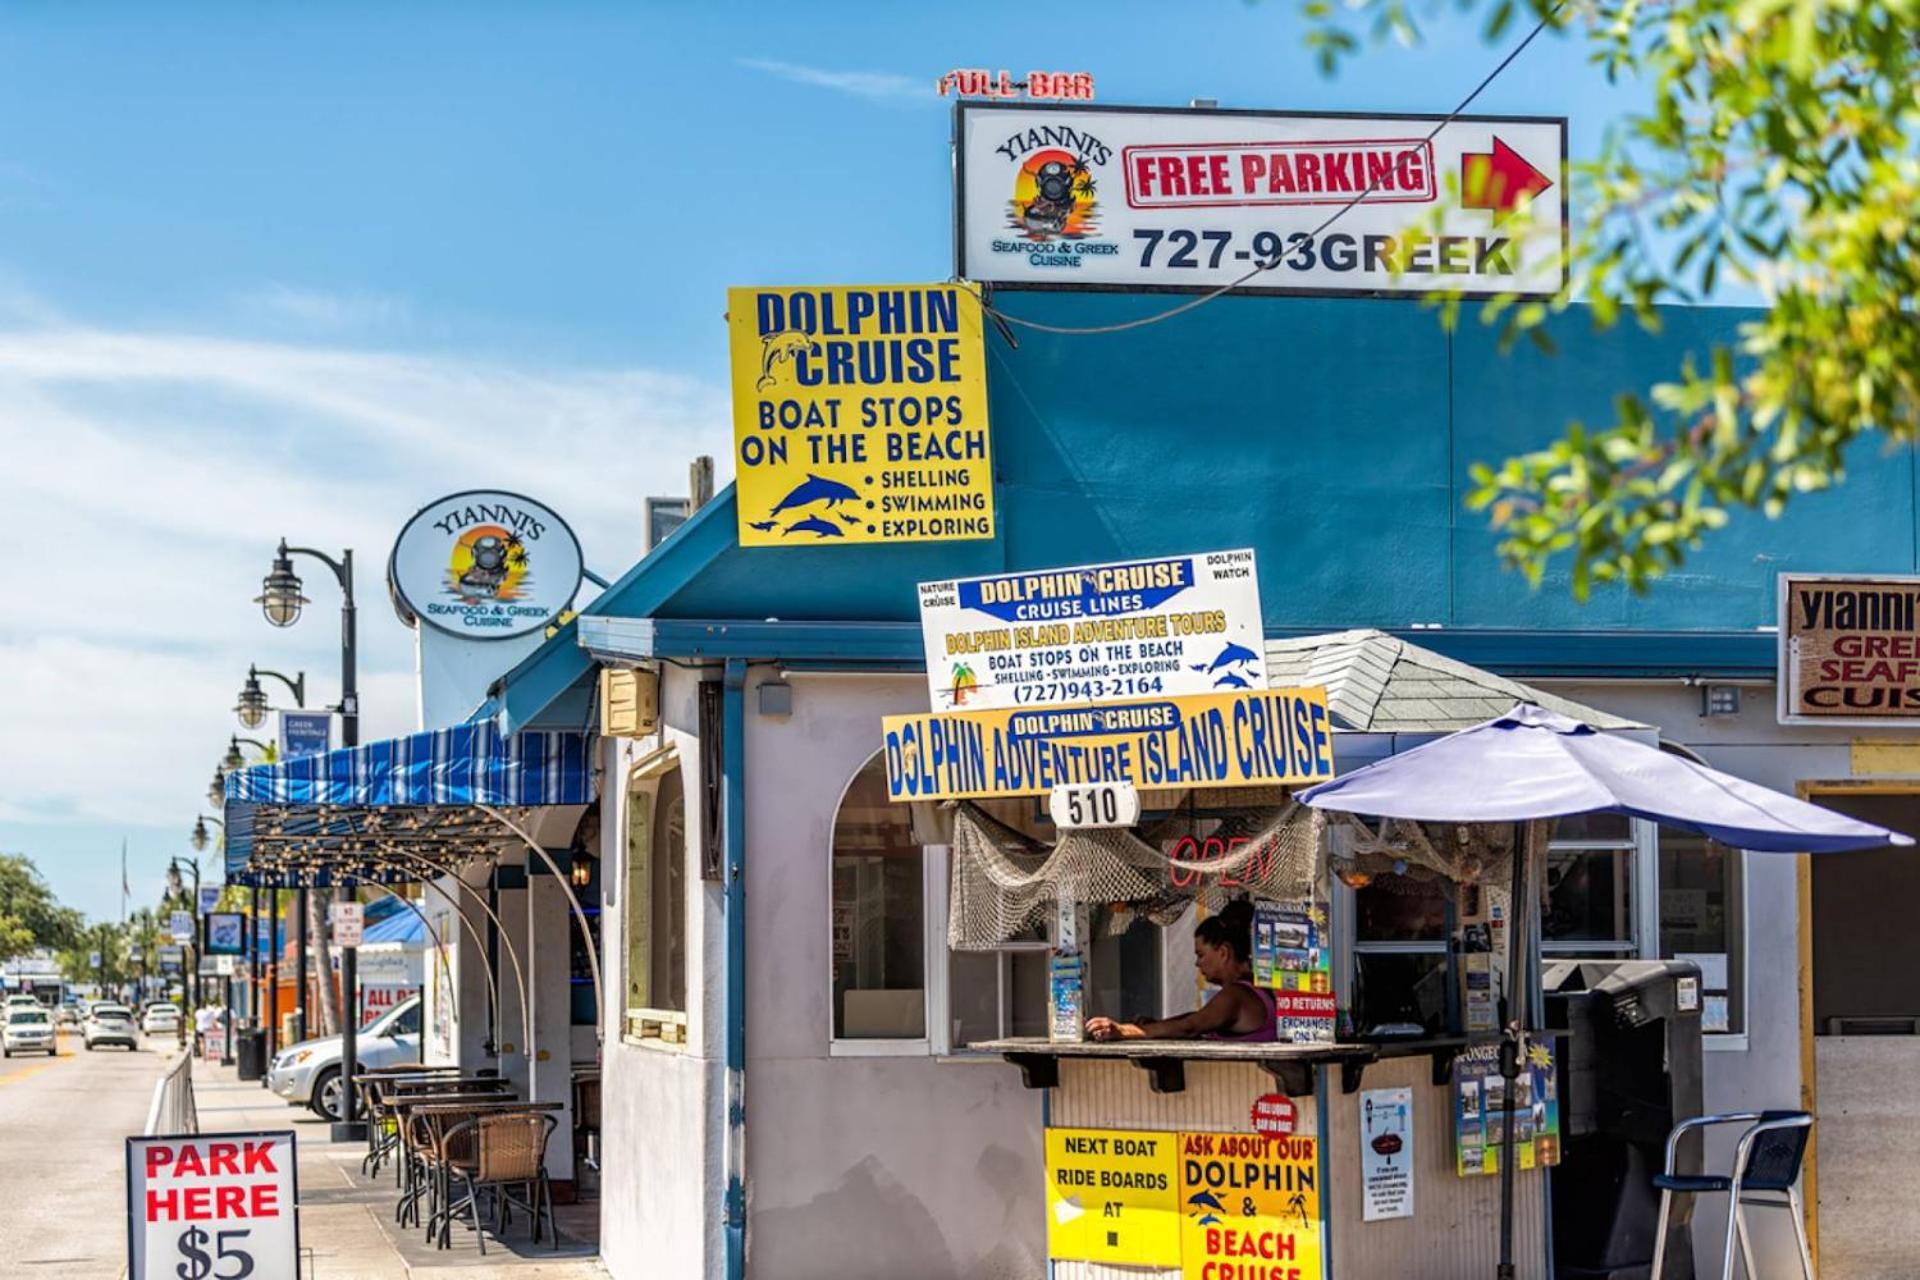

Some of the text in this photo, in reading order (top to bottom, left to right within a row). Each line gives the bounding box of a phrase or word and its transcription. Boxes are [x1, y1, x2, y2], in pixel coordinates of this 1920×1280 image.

[937, 69, 1095, 100] FULL BAR
[995, 125, 1113, 166] YIANNI'S
[1135, 149, 1424, 197] FREE PARKING
[992, 240, 1119, 255] SEAFOOD & GREEK
[1030, 253, 1082, 267] CUISINE
[1132, 228, 1514, 276] 727-93GREEK
[757, 290, 959, 336] DOLPHIN
[795, 338, 962, 387] CRUISE
[758, 396, 963, 430] BOAT STOPS
[740, 430, 986, 467] ON THE BEACH
[882, 468, 970, 488] SHELLING
[882, 493, 985, 512] SWIMMING
[433, 504, 546, 541] YIANNI'S
[883, 517, 990, 537] EXPLORING
[1207, 552, 1252, 566] DOLPHIN
[980, 562, 1185, 604] DOLPHIN CRUISE
[1213, 567, 1250, 580] WATCH
[920, 582, 956, 594] NATURE
[427, 603, 550, 617] SEAFOOD & GREEK
[923, 596, 957, 608] CRUISE
[1016, 594, 1143, 620] CRUISE LINES
[463, 616, 513, 627] CUISINE
[946, 609, 1228, 656] DOLPHIN ISLAND ADVENTURE TOURS
[989, 640, 1184, 670] BOAT STOPS ON THE BEACH
[1833, 635, 1920, 659] GRE
[1820, 659, 1920, 682] SEAF
[1014, 676, 1164, 703] (727)943-2164
[1014, 706, 1174, 736] DOLPHIN CRUISE
[886, 696, 1332, 796] DOLPHIN ADVENTURE ISLAND CRUISE
[1068, 788, 1118, 825] 510
[1169, 835, 1277, 888] OPEN
[368, 989, 393, 1006] ALL
[1292, 997, 1335, 1011] RETURNS
[1282, 1017, 1332, 1030] EXCHANGE
[145, 1141, 278, 1178] PARK
[1065, 1137, 1157, 1157] NEXT BOAT
[1184, 1135, 1314, 1161] ASK ABOUT OUR
[1057, 1169, 1167, 1190] RIDE BOARDS
[1185, 1160, 1315, 1192] DOLPHIN
[146, 1184, 280, 1222] HERE
[1104, 1202, 1123, 1218] AT
[1242, 1196, 1257, 1217] &
[176, 1224, 255, 1280] $5
[1205, 1228, 1296, 1261] BEACH
[1202, 1261, 1301, 1280] CRUISE
